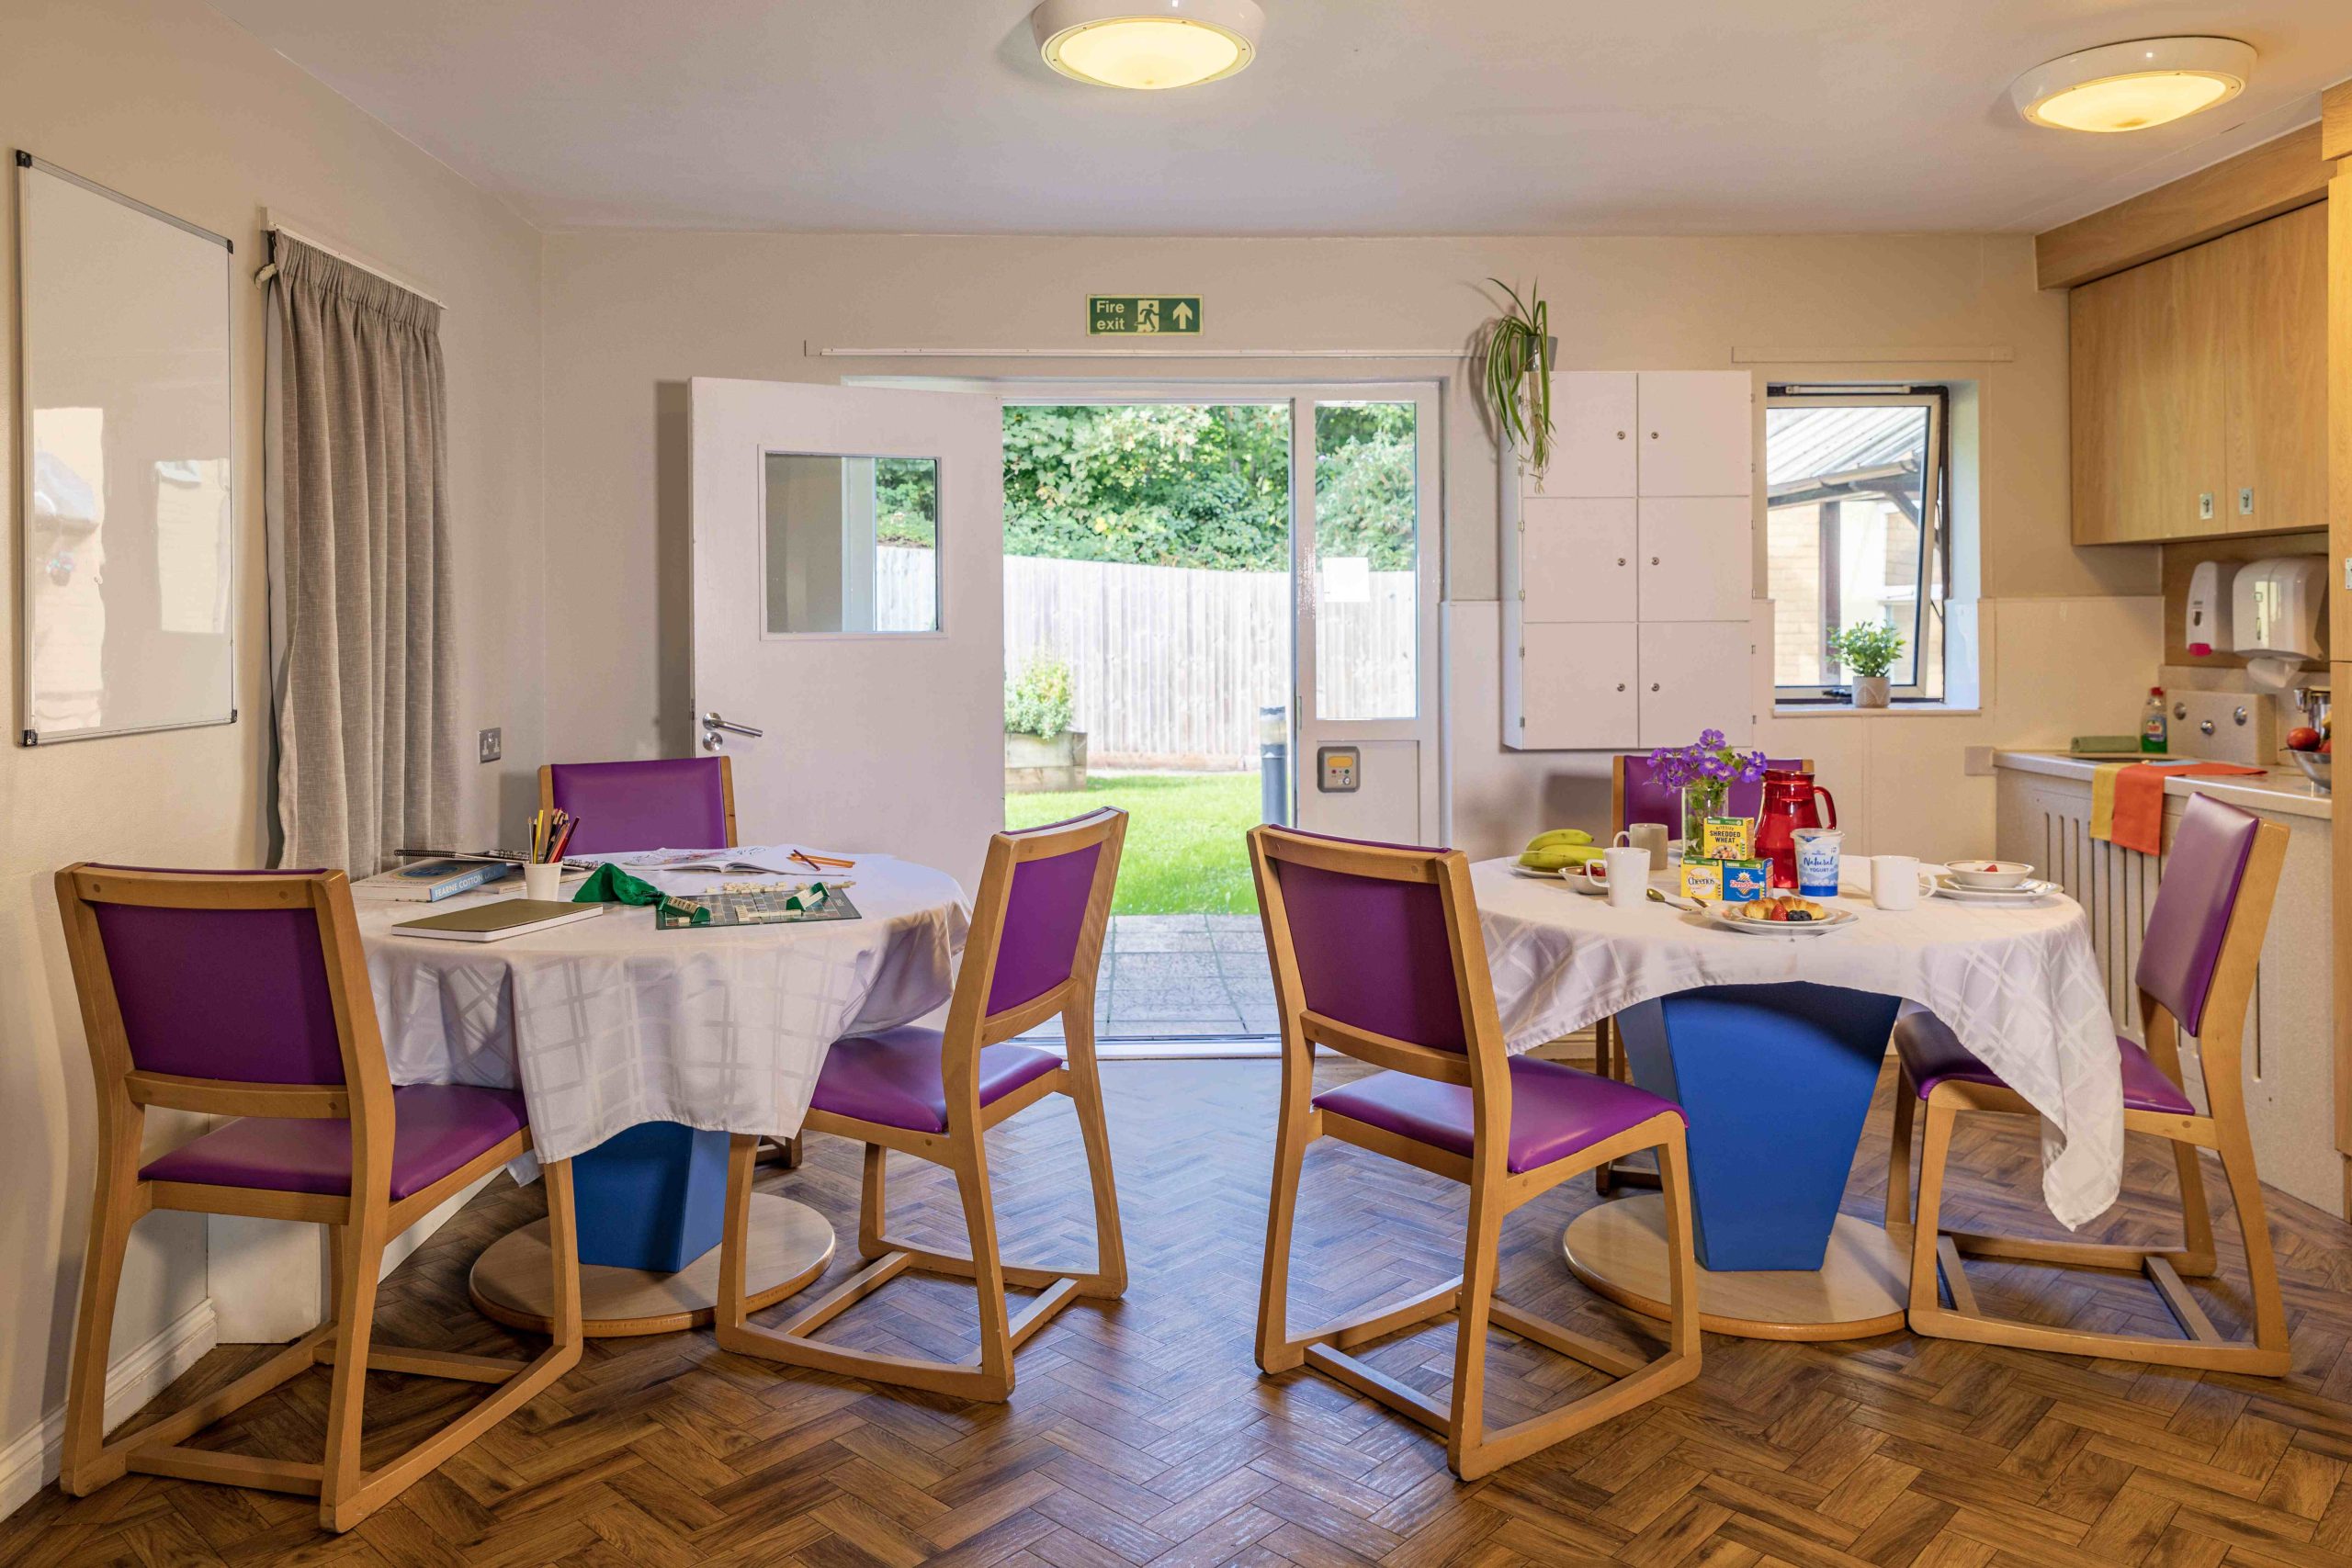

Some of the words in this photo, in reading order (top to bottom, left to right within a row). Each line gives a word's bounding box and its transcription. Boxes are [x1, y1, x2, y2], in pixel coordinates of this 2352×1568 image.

[1096, 300, 1125, 313] Fire
[1096, 318, 1125, 330] exit
[1804, 856, 1834, 866] Natural
[435, 882, 458, 897] FEARNE
[458, 874, 483, 889] COTTON
[1688, 877, 1715, 886] Cheerios
